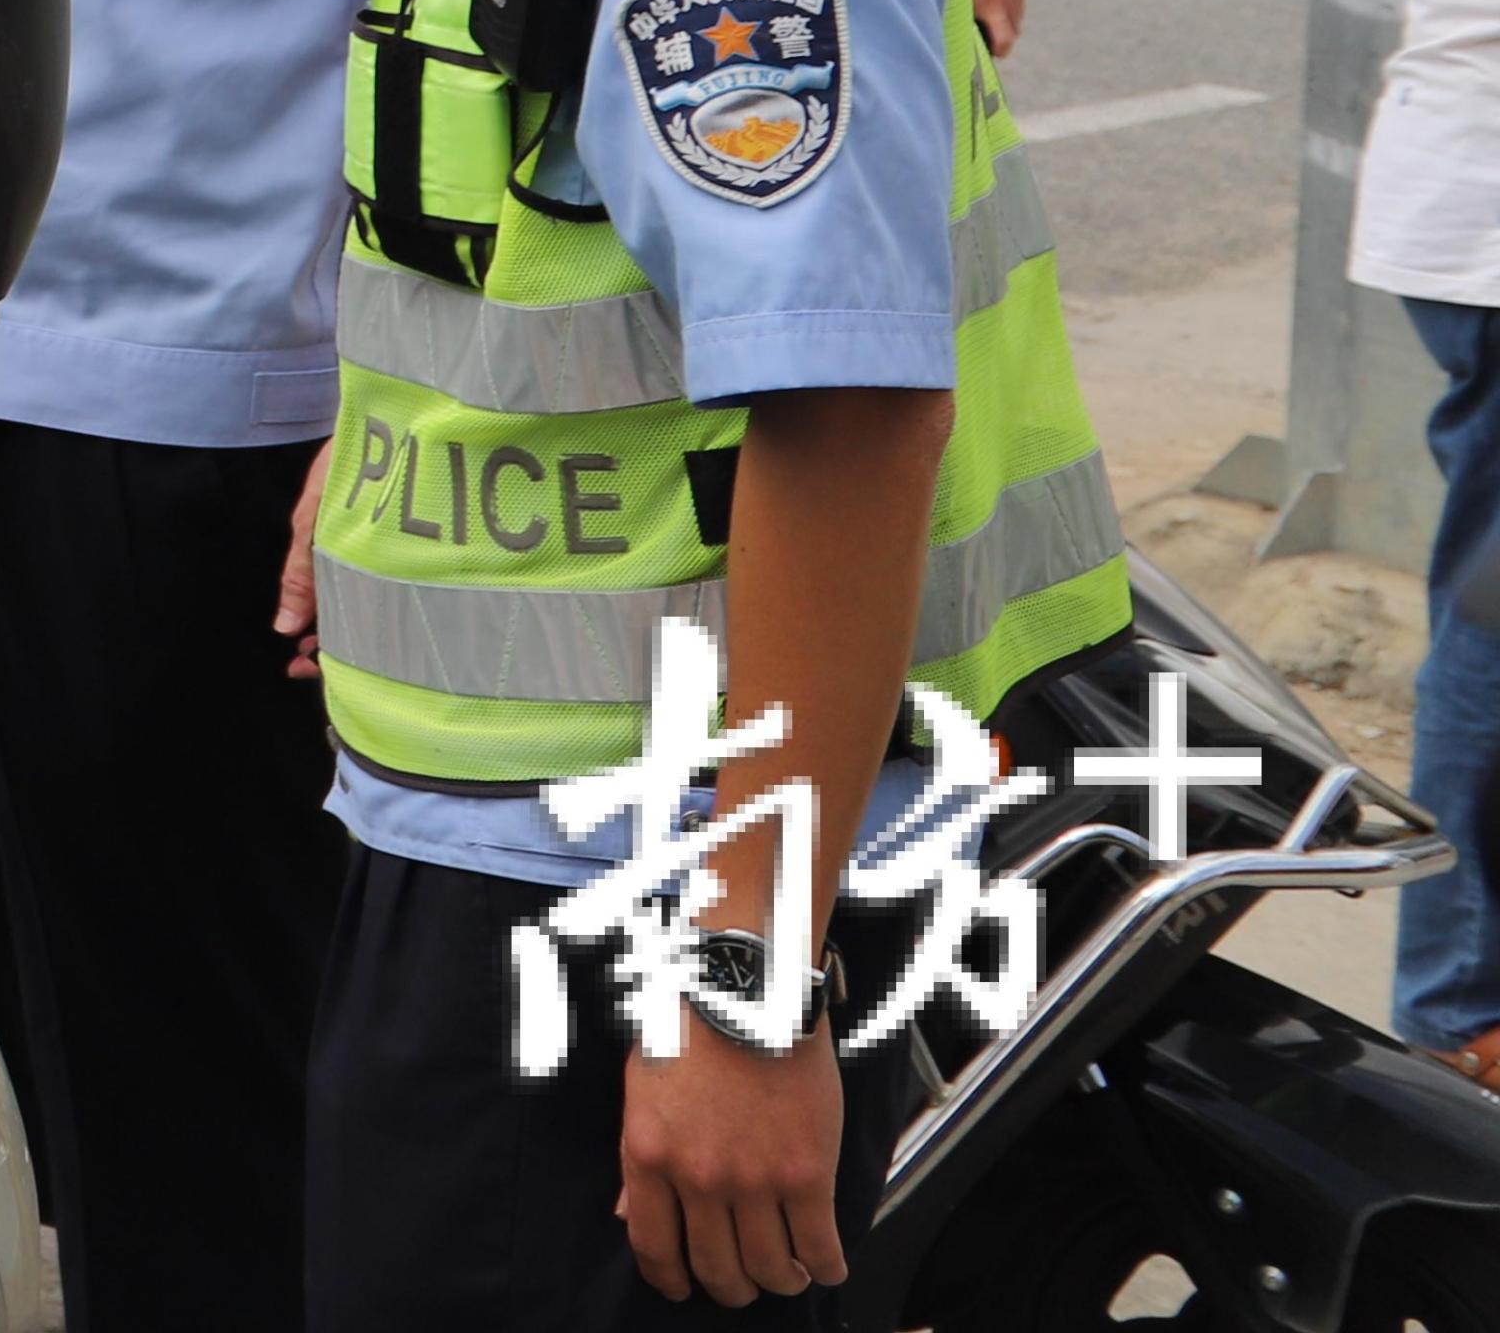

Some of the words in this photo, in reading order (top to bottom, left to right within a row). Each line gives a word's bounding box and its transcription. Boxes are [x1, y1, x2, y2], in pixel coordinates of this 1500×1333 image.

[654, 31, 695, 76] 辅
[768, 14, 814, 59] 警
[700, 72, 786, 95] FUJING
